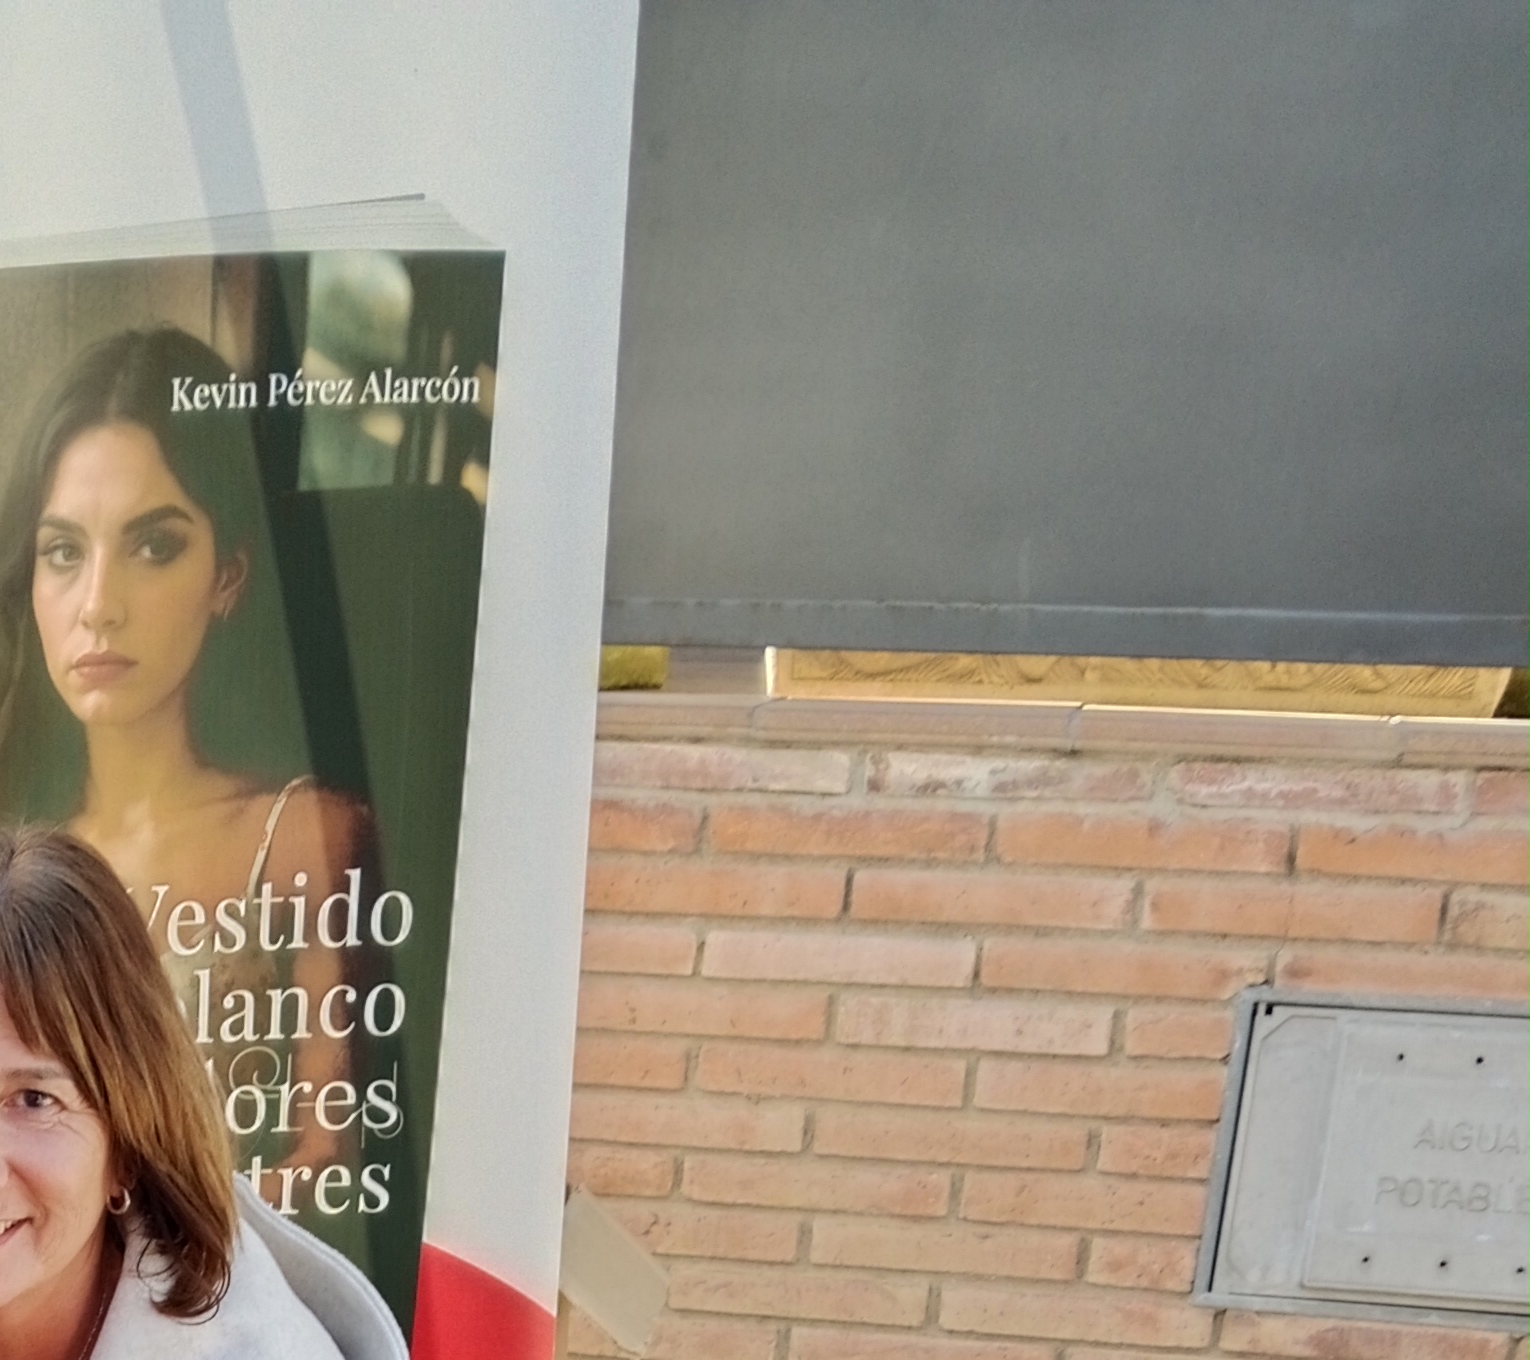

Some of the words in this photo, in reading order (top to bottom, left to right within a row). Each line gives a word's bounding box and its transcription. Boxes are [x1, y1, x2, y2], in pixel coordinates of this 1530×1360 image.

[170, 373, 258, 412] Kevin
[267, 366, 355, 407] Pérez
[359, 364, 481, 404] Alarcón
[192, 967, 407, 1043] lanco
[1412, 1118, 1520, 1155] AIGUA
